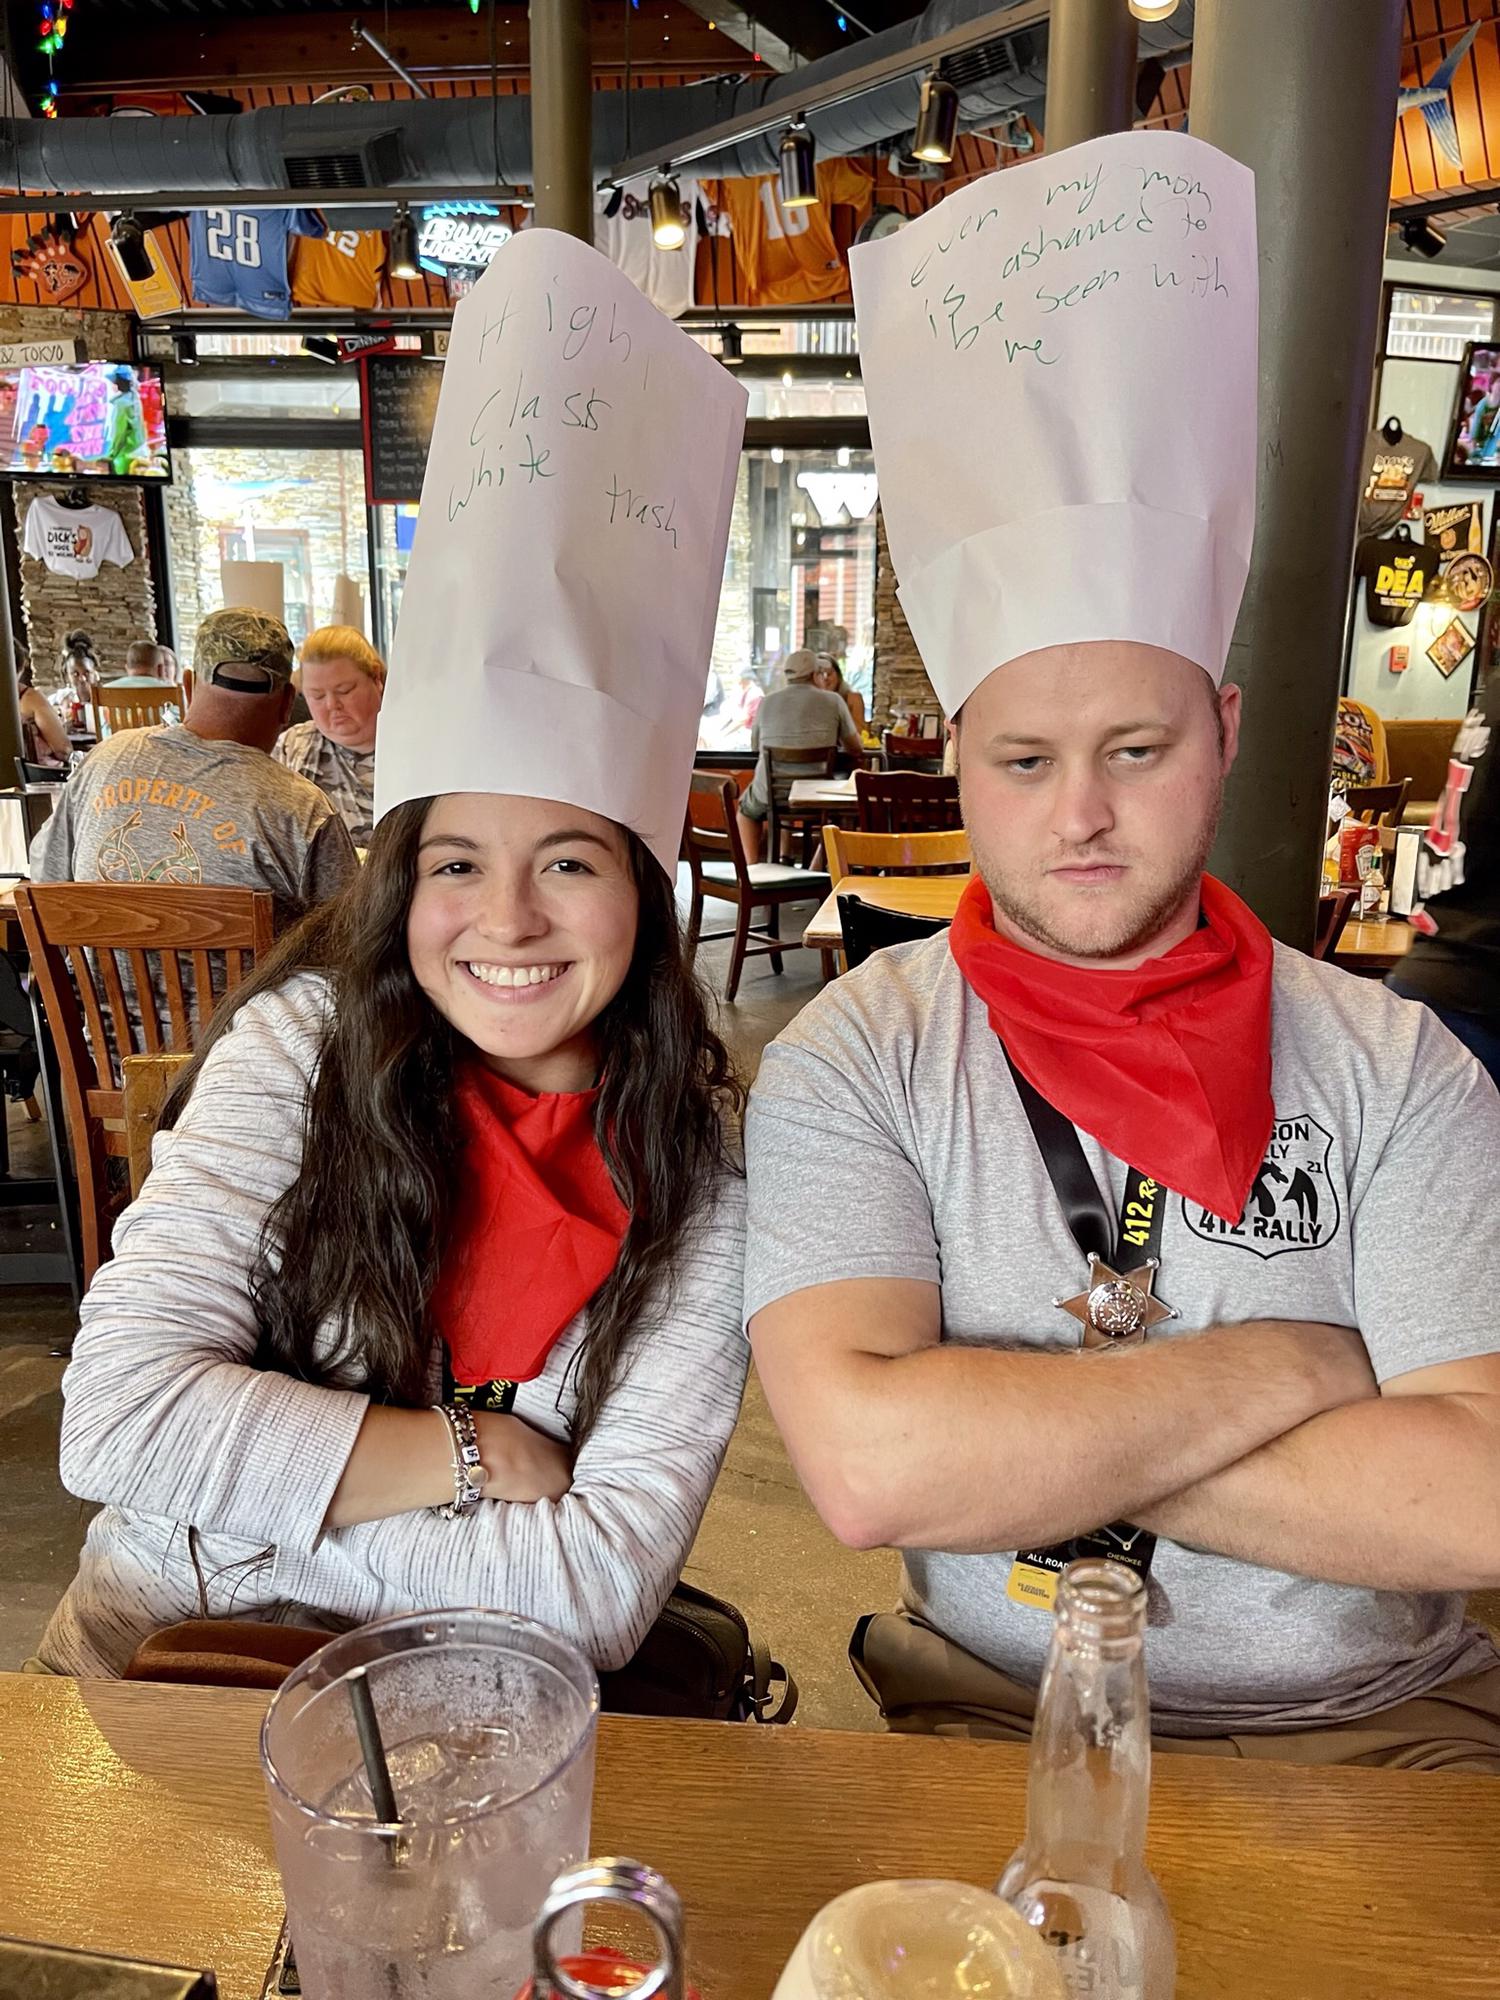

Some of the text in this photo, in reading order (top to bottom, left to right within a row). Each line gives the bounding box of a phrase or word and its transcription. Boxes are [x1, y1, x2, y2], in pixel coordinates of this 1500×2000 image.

[1046, 163, 1103, 214] my
[1134, 166, 1212, 213] mom
[206, 207, 262, 268] 28
[1002, 196, 1154, 280] ashamed
[1180, 205, 1208, 239] to
[1036, 271, 1120, 314] seen
[1152, 255, 1229, 298] with
[20, 344, 64, 362] TOKYO
[1004, 338, 1064, 365] me
[47, 531, 78, 544] DICK'S
[1375, 565, 1424, 598] DEA
[92, 776, 247, 855] PROPERTY OF
[1306, 1161, 1323, 1174] 21
[1122, 1201, 1154, 1247] 412
[1253, 1216, 1323, 1245] RALLY
[1027, 1553, 1044, 1564] ALL
